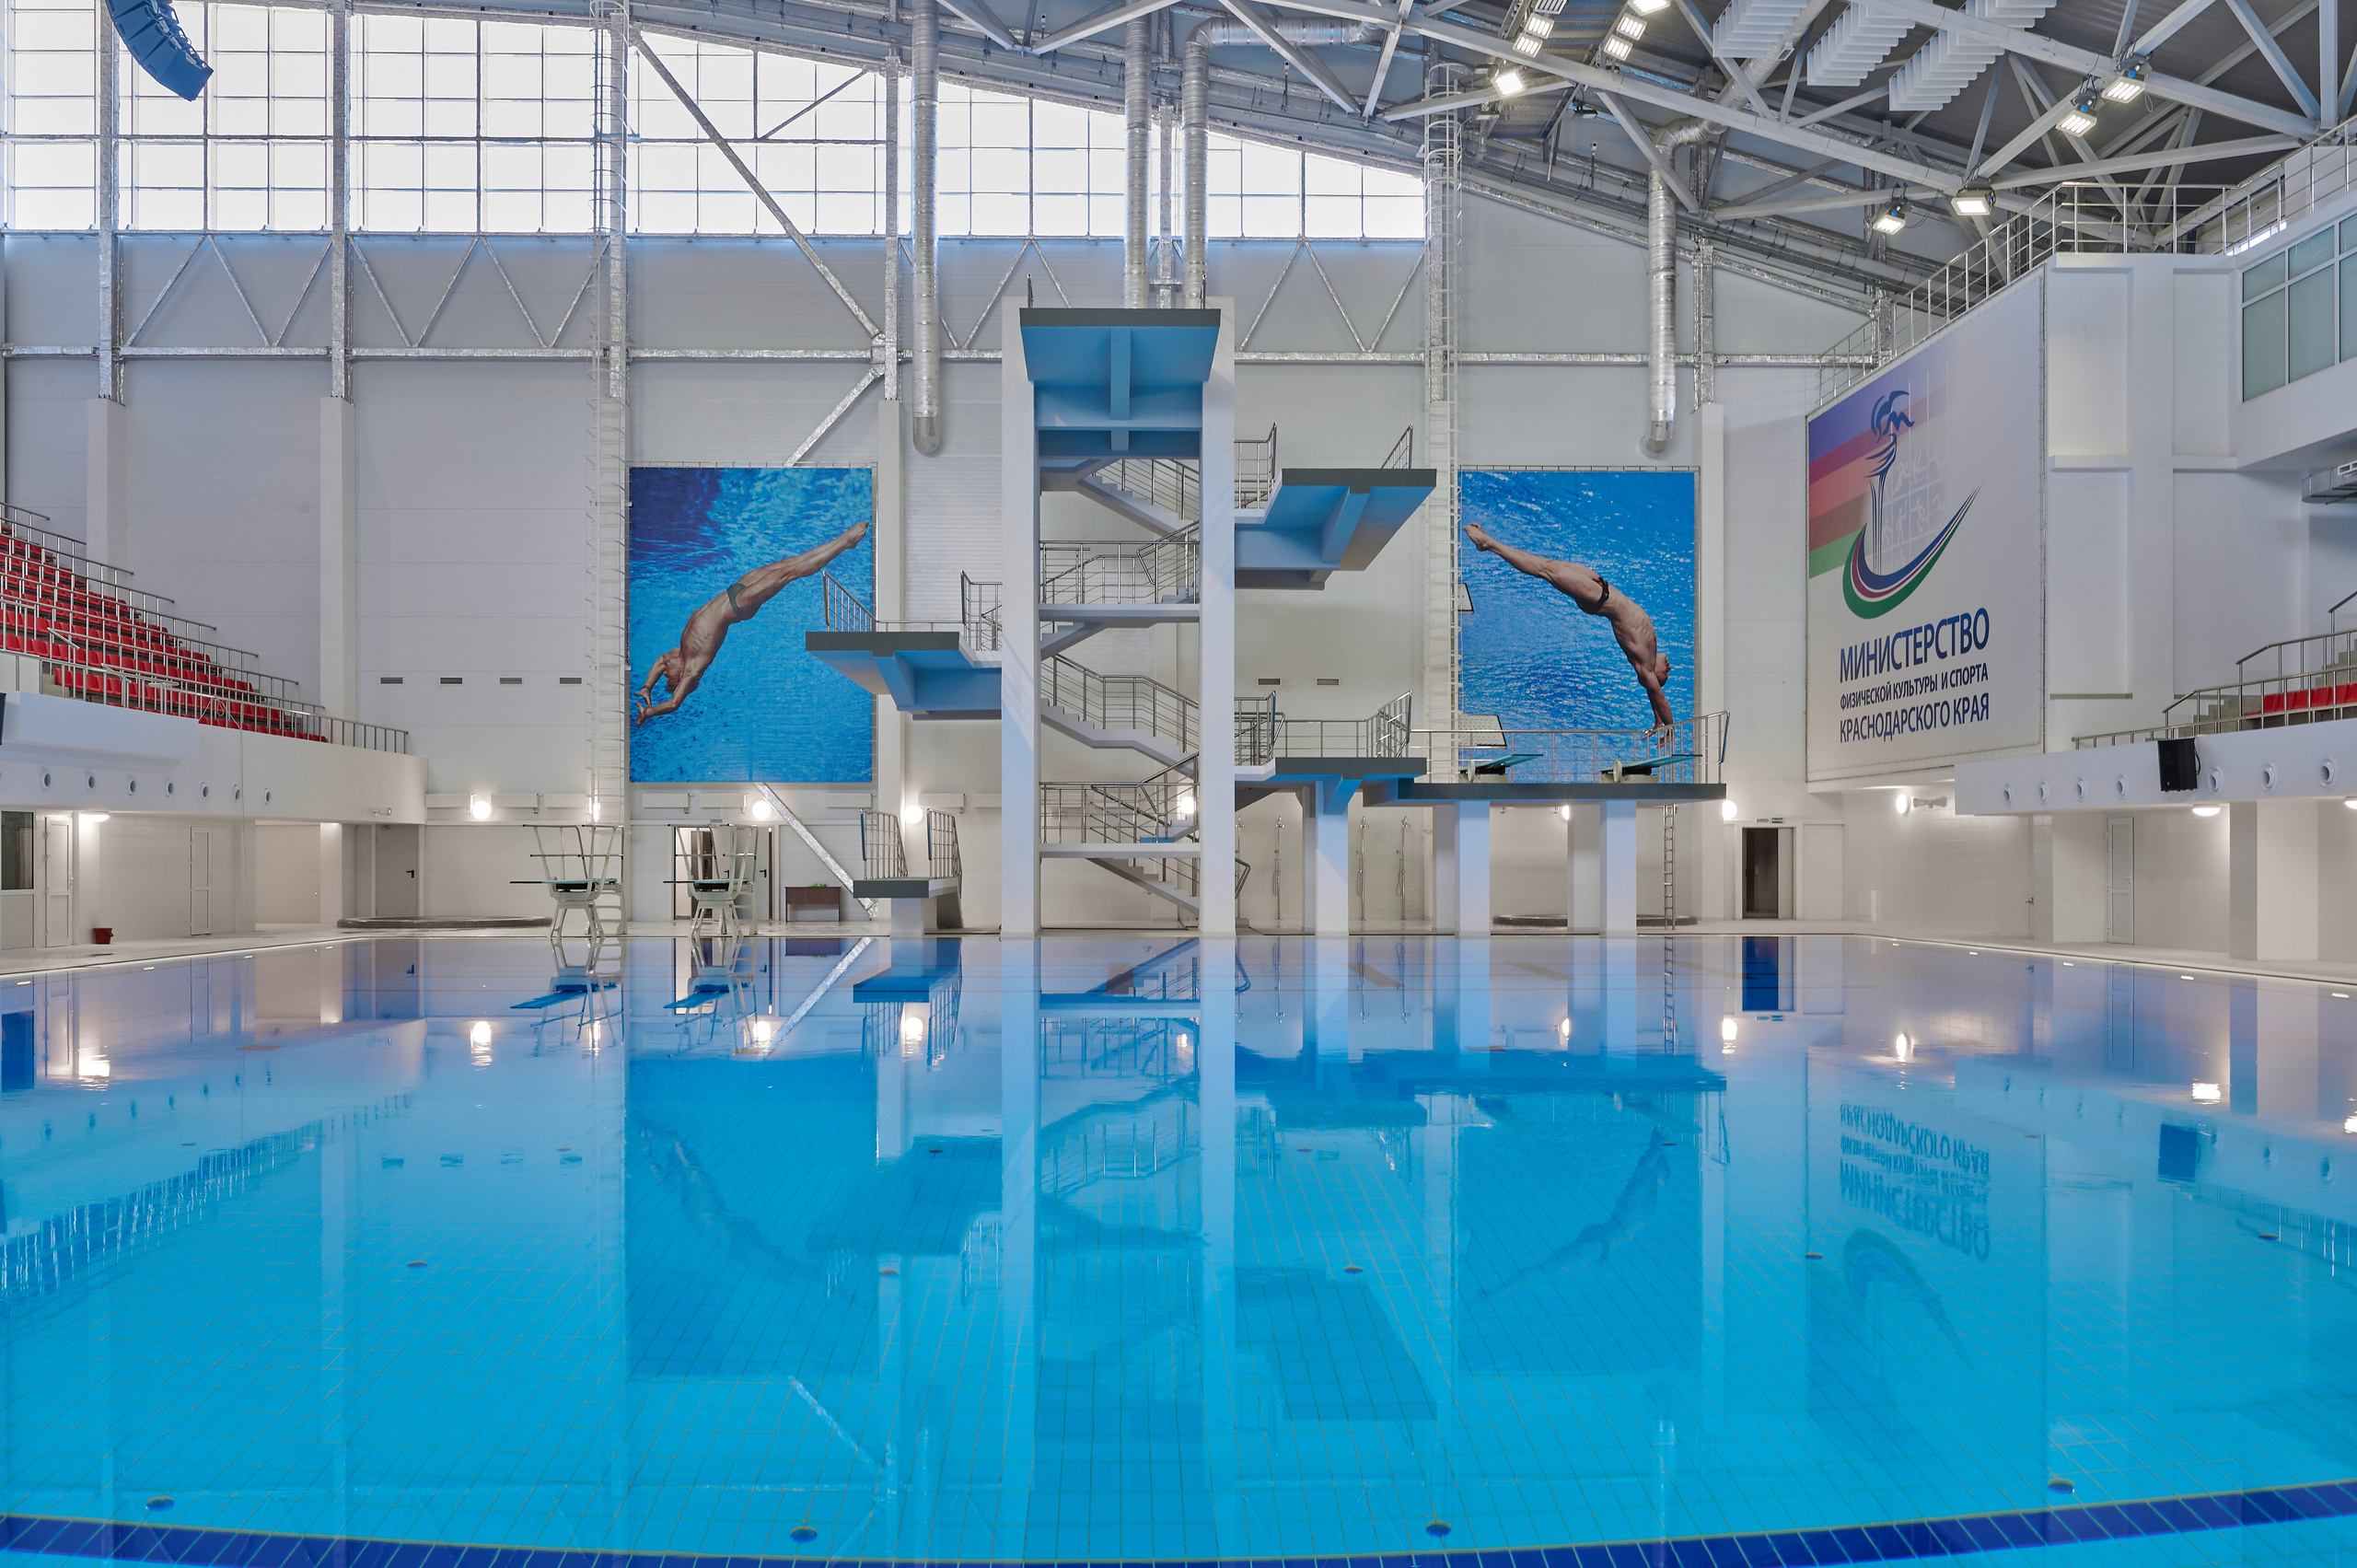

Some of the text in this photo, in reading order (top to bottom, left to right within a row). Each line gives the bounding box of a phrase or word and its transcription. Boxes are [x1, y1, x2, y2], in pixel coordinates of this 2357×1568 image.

[1840, 608, 1990, 683] МИНИСТЕРСТВО
[1840, 662, 1989, 711] ФИЗИЧЕСКОЙ КУЛЬТУРЫ И СПОРТА
[1840, 692, 1989, 743] КРАСНОДАРСКОГО КРАЯ
